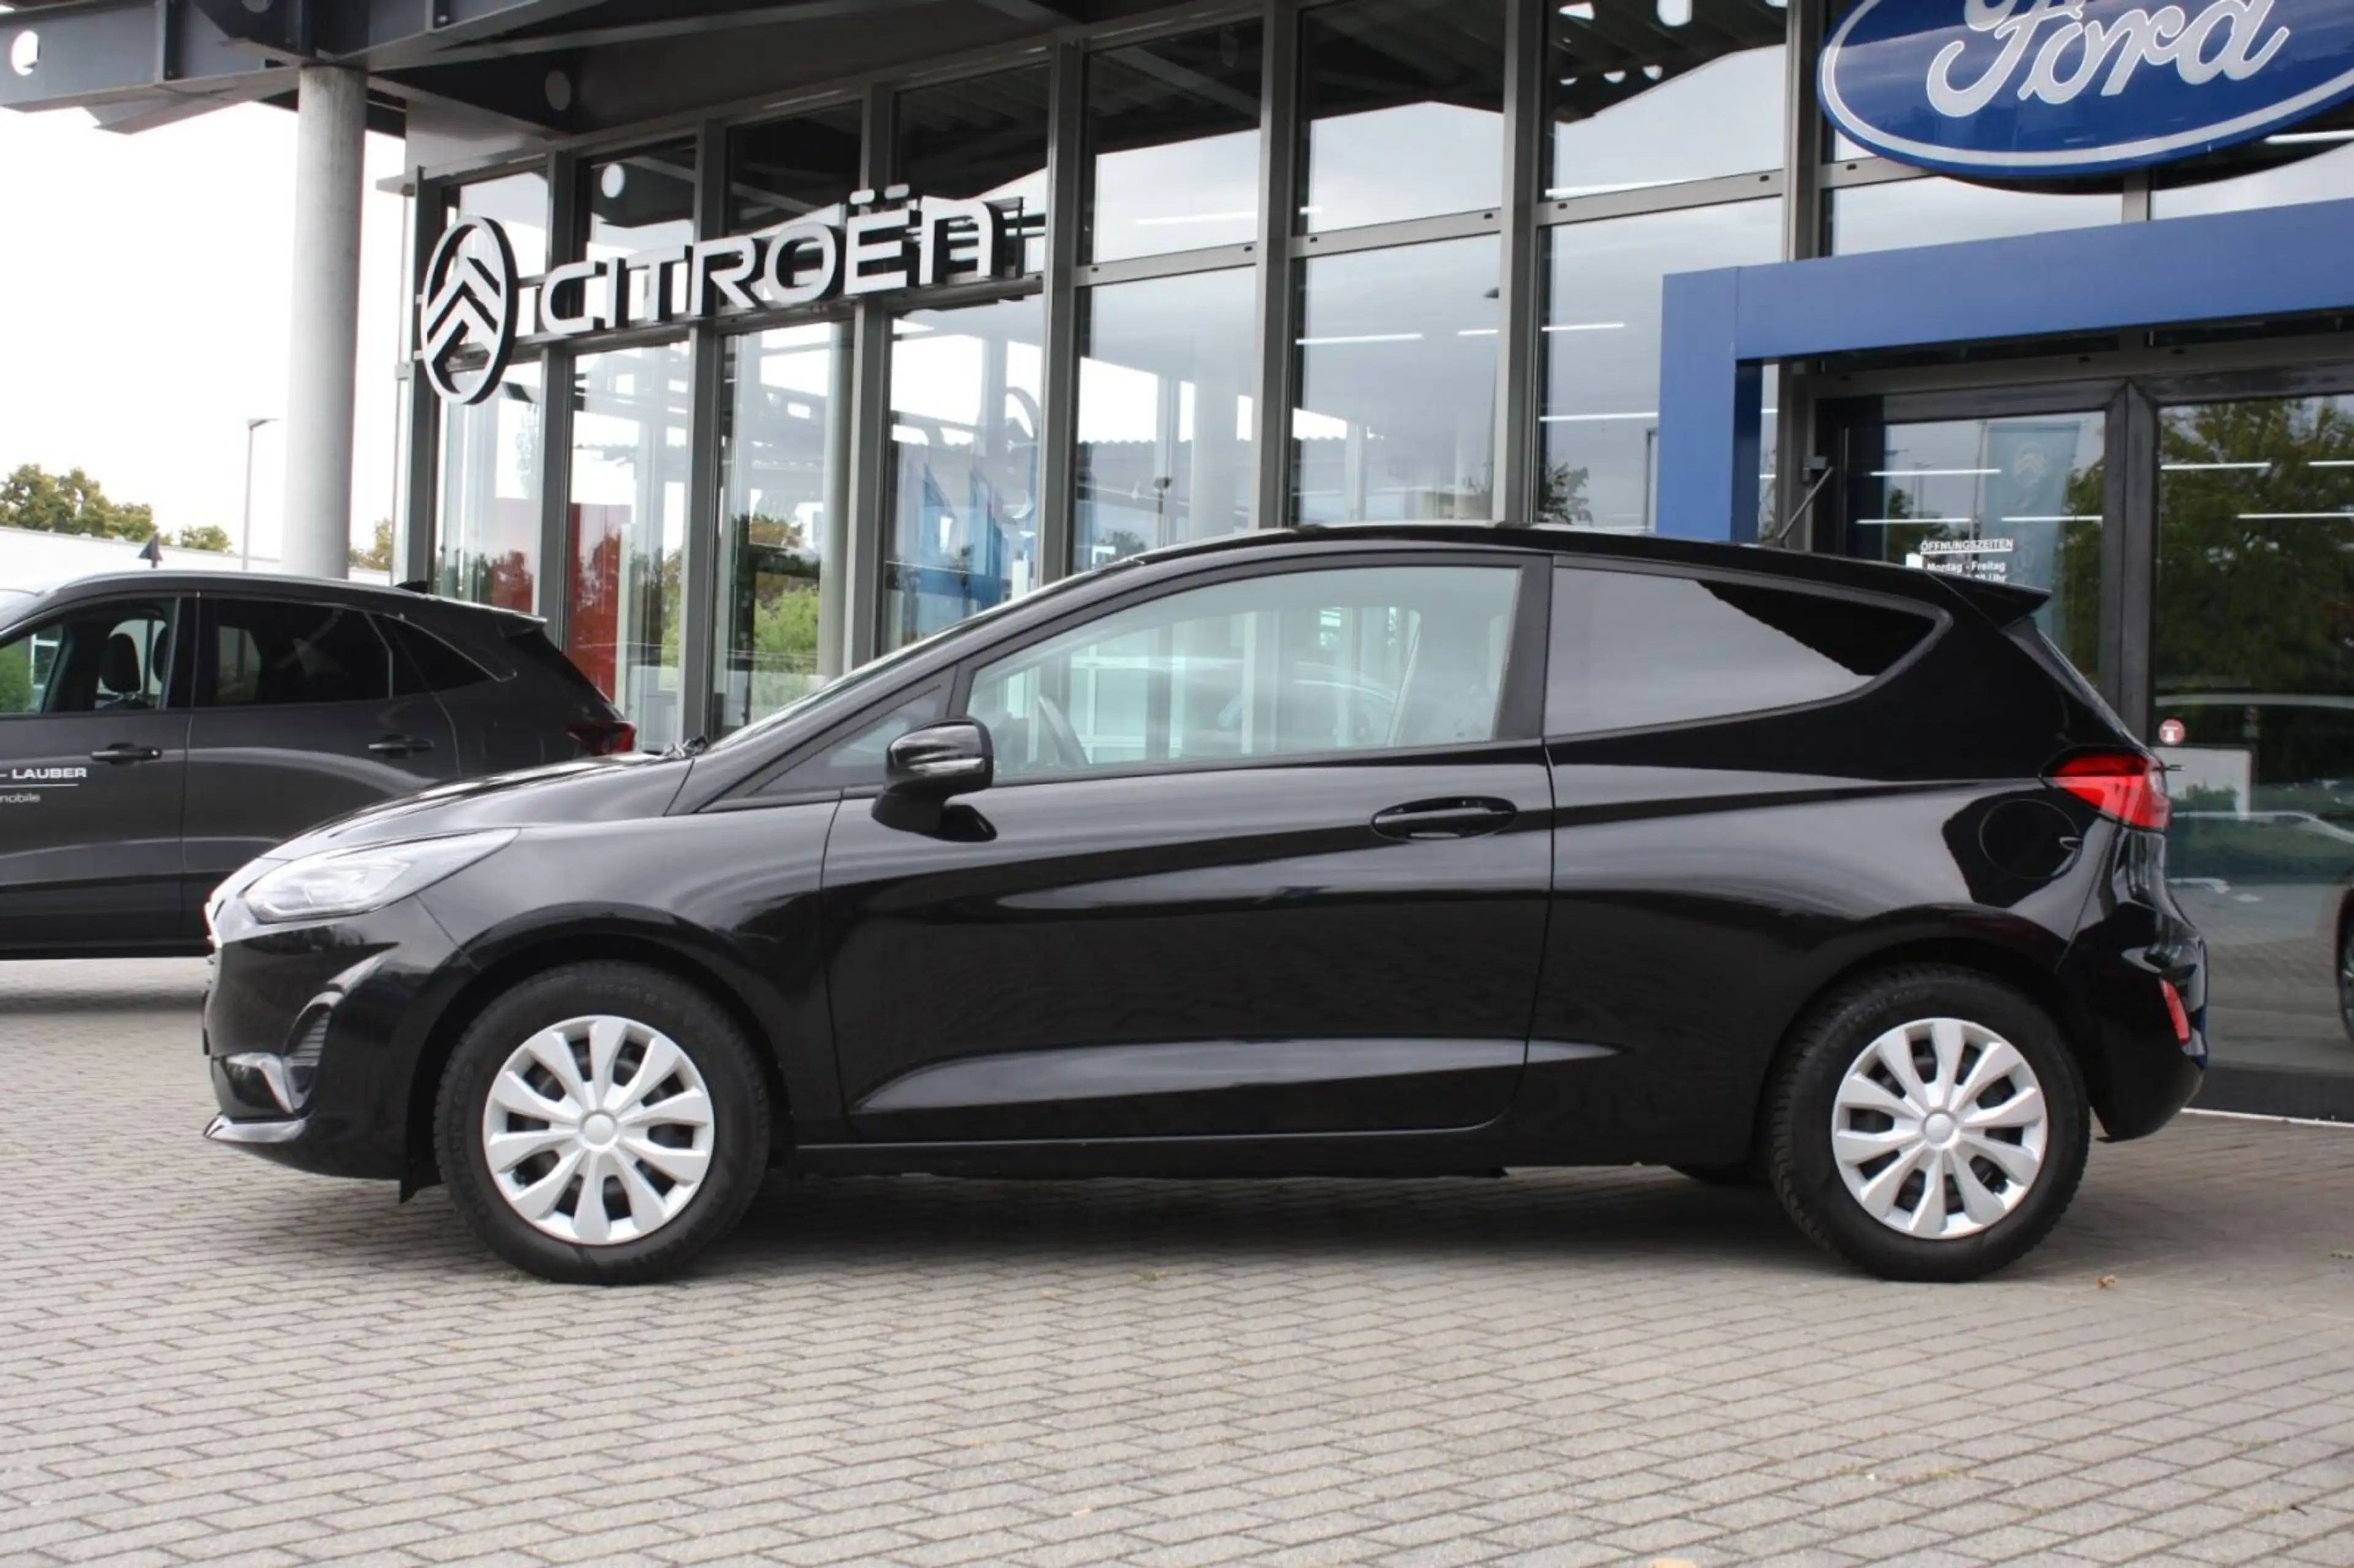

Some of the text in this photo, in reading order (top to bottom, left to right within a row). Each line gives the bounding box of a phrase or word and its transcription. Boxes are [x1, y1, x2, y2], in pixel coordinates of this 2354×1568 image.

[1926, 0, 2290, 117] Ford
[1921, 537, 2014, 551] ÖFFNUNGSZEITEN
[1927, 562, 1962, 573] Montag
[1971, 560, 2006, 573] Freitag
[12, 767, 87, 779] LAUBER
